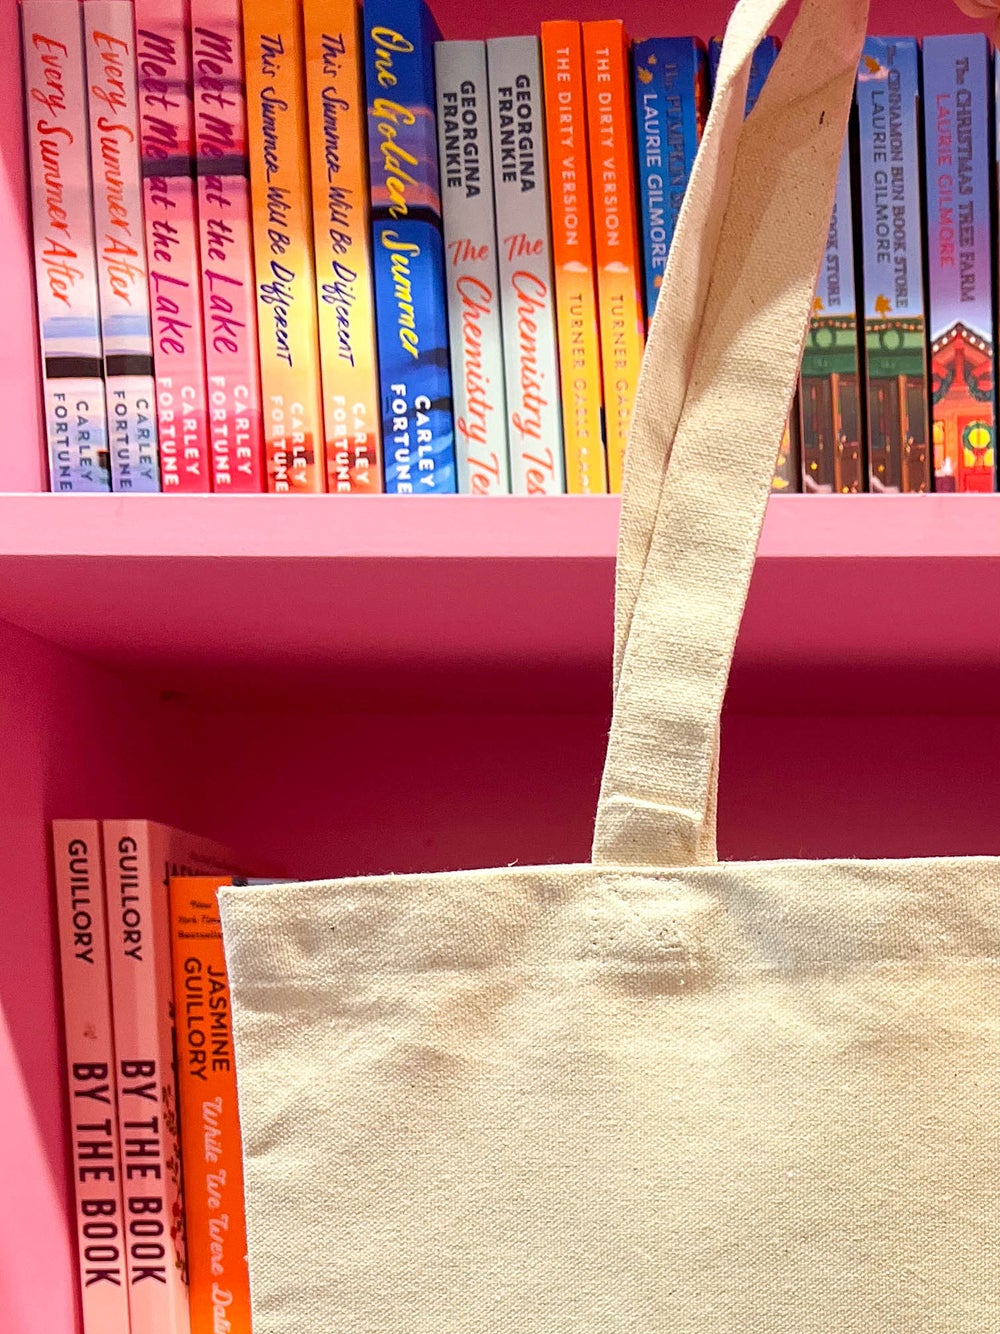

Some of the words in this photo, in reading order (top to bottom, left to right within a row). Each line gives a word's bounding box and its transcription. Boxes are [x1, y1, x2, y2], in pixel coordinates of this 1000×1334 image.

[31, 32, 69, 118] Every
[92, 30, 129, 115] Every
[138, 28, 180, 112] Meet
[194, 26, 236, 110] Meet
[371, 26, 415, 90] One
[556, 47, 571, 82] THE
[595, 47, 611, 82] THE
[142, 114, 179, 160] Me
[373, 98, 419, 221] Golden
[442, 92, 463, 188] FRANKIE
[460, 80, 481, 199] GEORGINA
[498, 86, 518, 184] FRANKIE
[515, 74, 536, 193] GEORGINA
[558, 92, 574, 148] DIRTY
[598, 92, 614, 148] DIRTY
[643, 94, 663, 169] LAURIE
[871, 90, 887, 164] LAURIE
[956, 88, 974, 197] CHRISTMAS
[37, 119, 74, 240] Summer
[97, 117, 134, 237] Summer
[561, 156, 579, 246] VERSION
[603, 157, 620, 247] VERSION
[873, 170, 891, 264] GILMORE
[890, 165, 904, 197] BUN
[152, 219, 181, 262] the
[447, 238, 489, 267] The
[503, 232, 544, 261] The
[647, 173, 668, 270] GILMORE
[891, 198, 908, 253] BOOK
[958, 200, 975, 248] TREE
[42, 236, 85, 308] After
[102, 234, 146, 307] After
[150, 270, 192, 355] Lake
[204, 269, 246, 354] Lake
[893, 253, 909, 309] STORE
[960, 245, 976, 302] FARM
[456, 275, 494, 445] Chemistry
[570, 294, 586, 369] TURNER
[53, 393, 72, 491] FORTUNE
[76, 400, 93, 482] CARLEY
[113, 390, 132, 489] FORTUNE
[136, 398, 153, 480] CARLEY
[158, 377, 179, 486] FORTUNE
[180, 385, 200, 476] CARLEY
[210, 375, 232, 485] FORTUNE
[233, 384, 252, 475] CARLEY
[414, 395, 435, 488] CARLEY
[68, 839, 94, 965] GUILLORY
[117, 835, 143, 962] GUILLORY
[183, 956, 208, 1081] GUILLORY
[206, 964, 231, 1073] JASMINE
[72, 1062, 111, 1105] BY
[120, 1059, 161, 1103] BY
[76, 1118, 116, 1183] THE
[124, 1116, 162, 1180] THE
[202, 1095, 223, 1164] While
[81, 1199, 121, 1288] BOOK
[128, 1196, 167, 1285] BOOK
